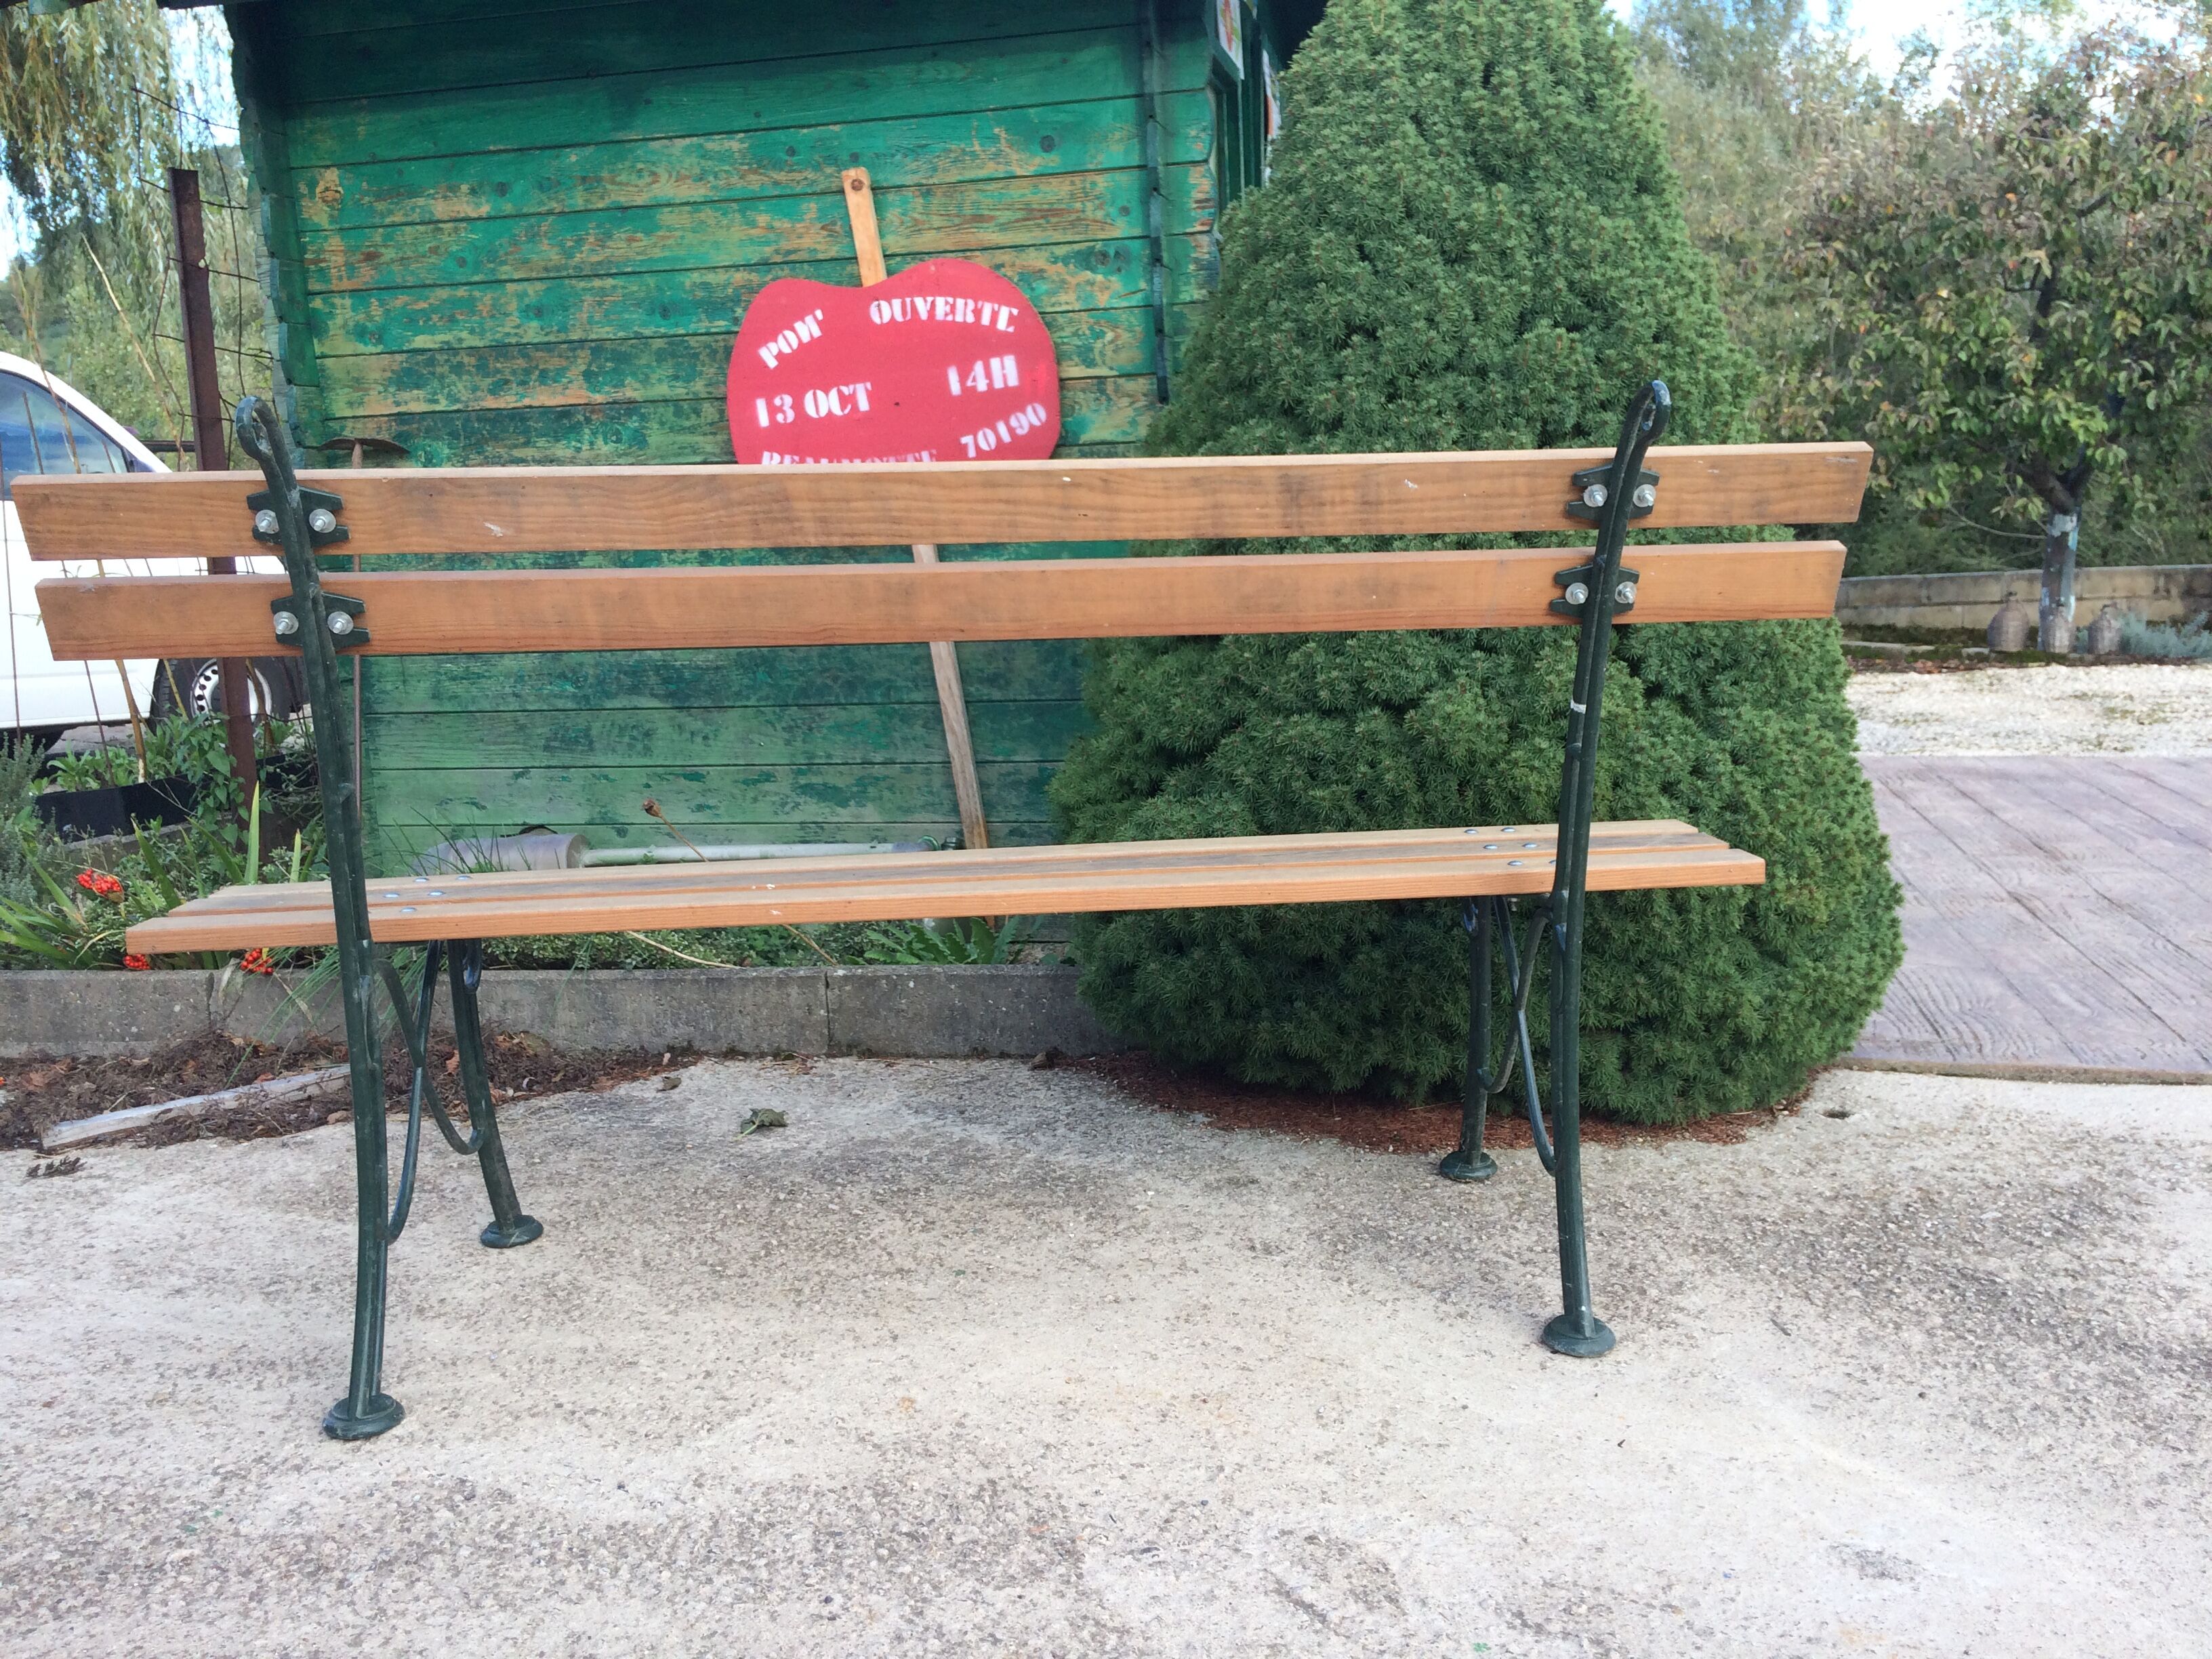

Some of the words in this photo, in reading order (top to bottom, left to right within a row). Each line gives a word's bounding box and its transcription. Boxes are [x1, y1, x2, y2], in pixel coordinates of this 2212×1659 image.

[869, 296, 1019, 333] OUVERTE
[756, 394, 796, 428] 13
[804, 382, 872, 419] OCT
[947, 354, 1019, 396] 14H
[960, 403, 1047, 458] 70190
